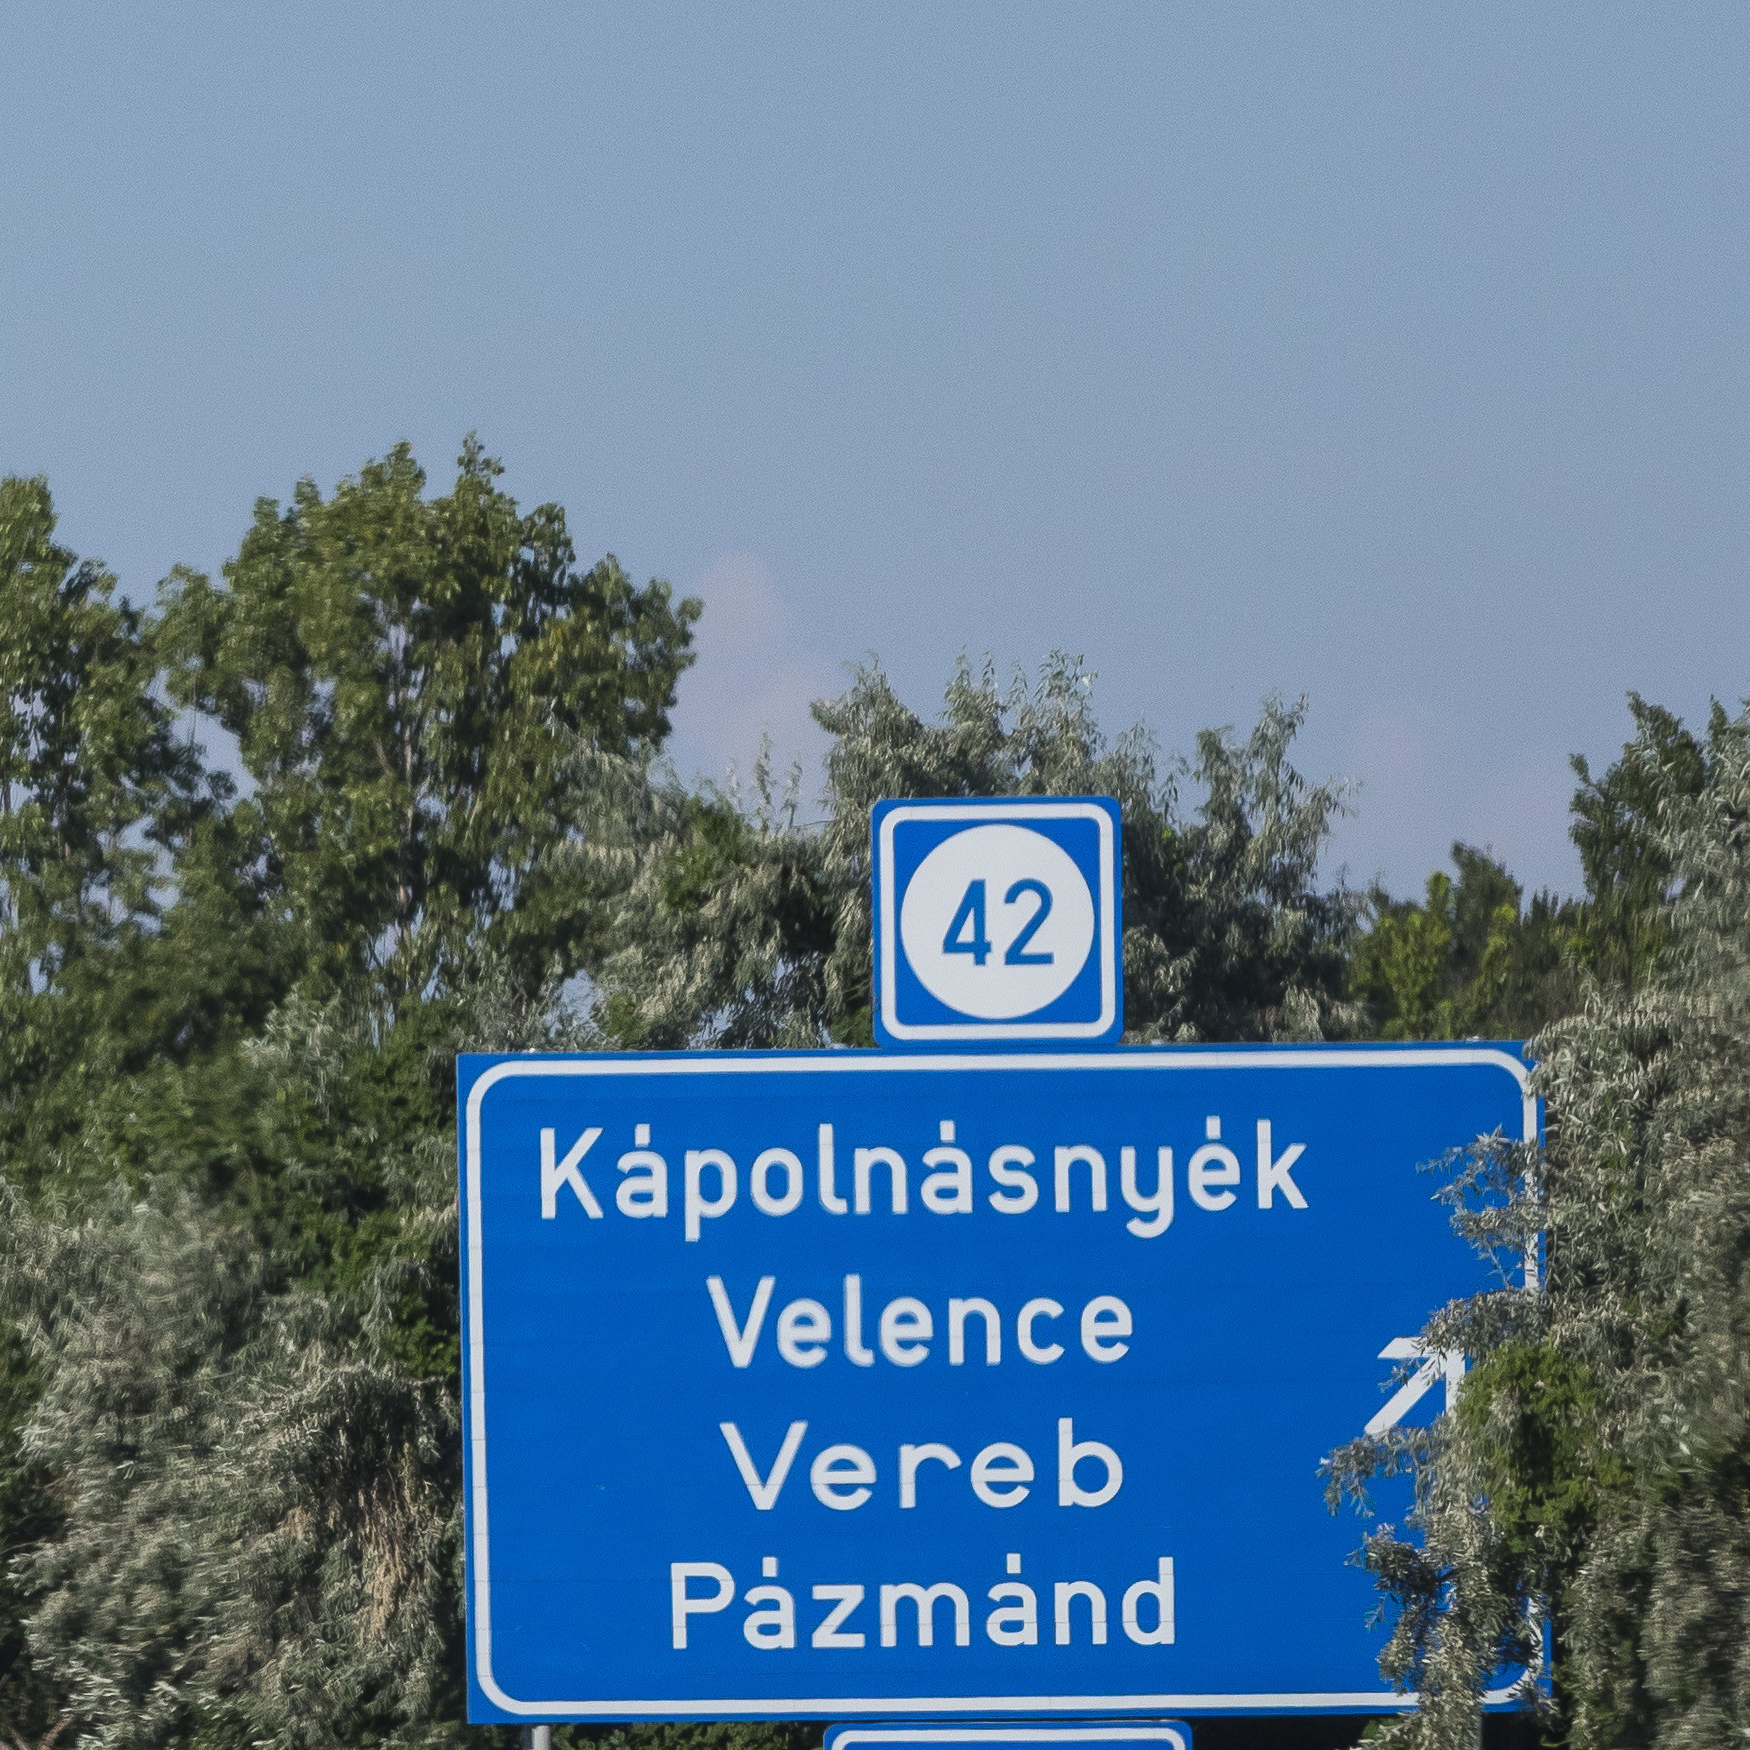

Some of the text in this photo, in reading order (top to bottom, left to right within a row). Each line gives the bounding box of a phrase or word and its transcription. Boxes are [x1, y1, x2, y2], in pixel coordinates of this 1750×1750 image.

[942, 878, 1055, 966] 42
[539, 1115, 1309, 1242] Kápolnásnyék
[706, 1273, 1134, 1368] Velence
[719, 1416, 1124, 1511] Vereb
[670, 1552, 1176, 1650] Pázmánd
